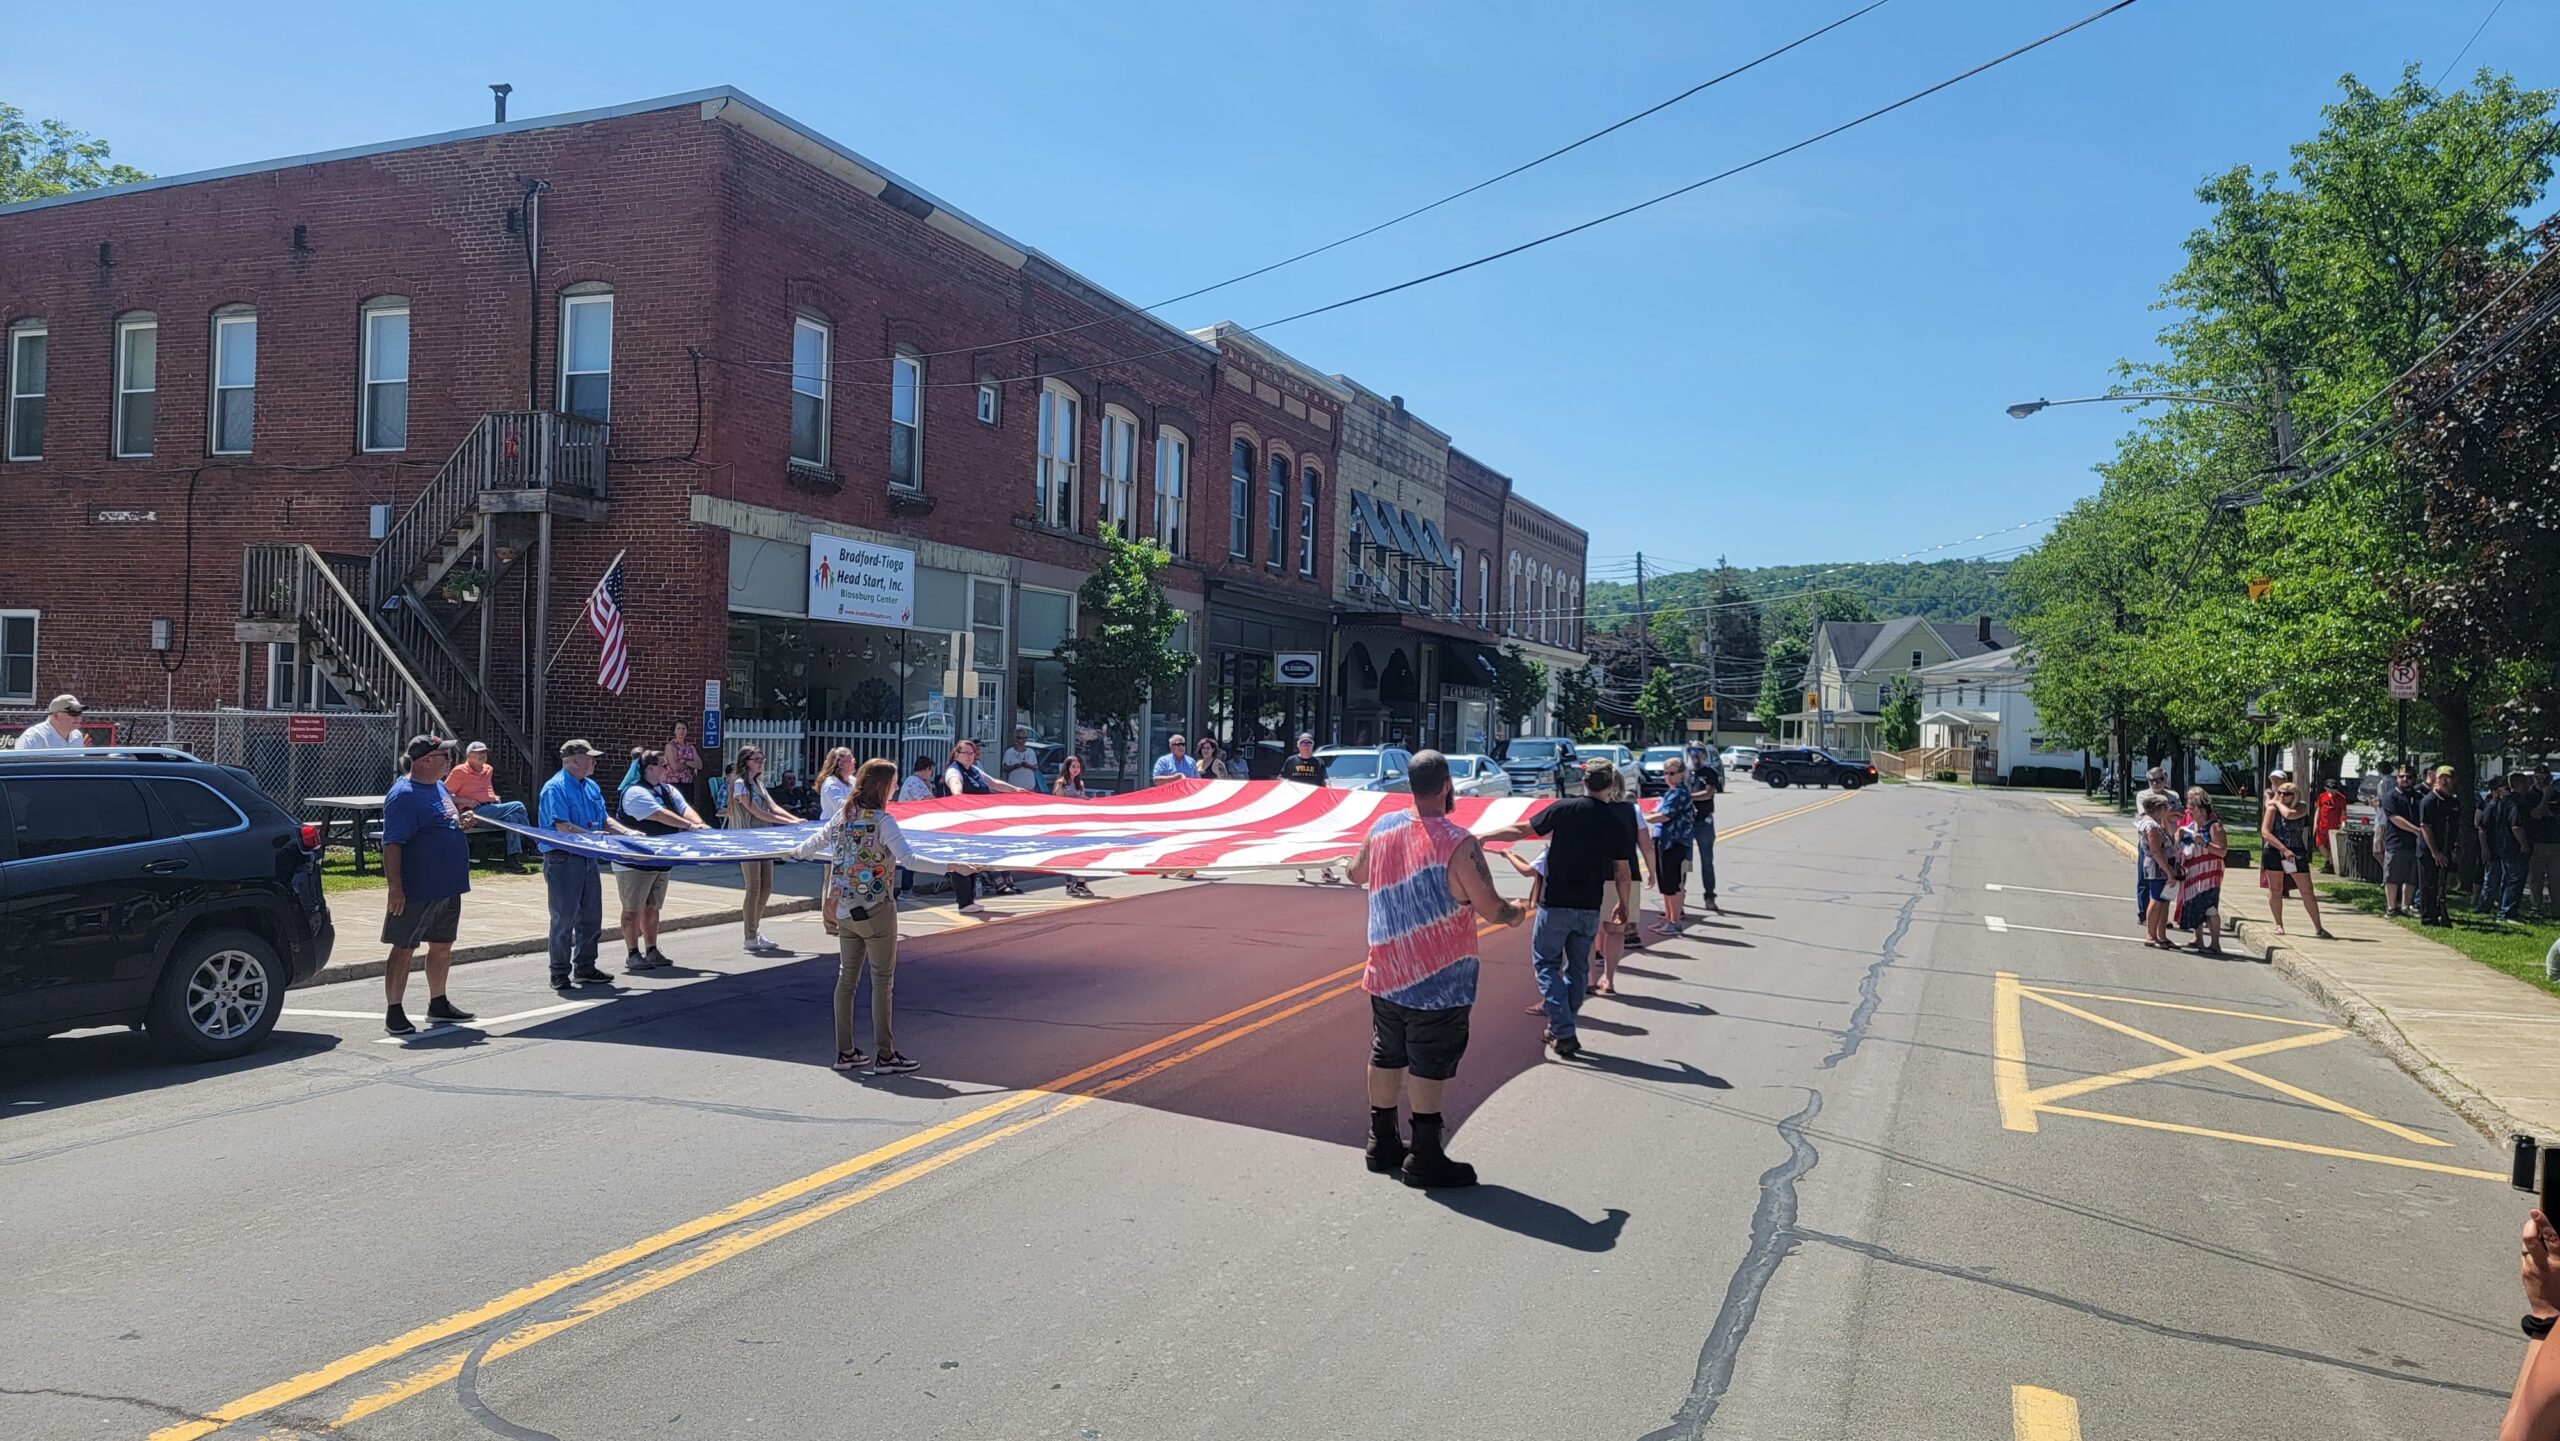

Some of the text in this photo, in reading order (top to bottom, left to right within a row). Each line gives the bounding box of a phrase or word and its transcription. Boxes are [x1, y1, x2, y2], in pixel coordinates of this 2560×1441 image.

[839, 548, 904, 573] Bradford-Tioga
[837, 570, 904, 591] Head Start, Inc.
[840, 589, 898, 604] Blossburg Center
